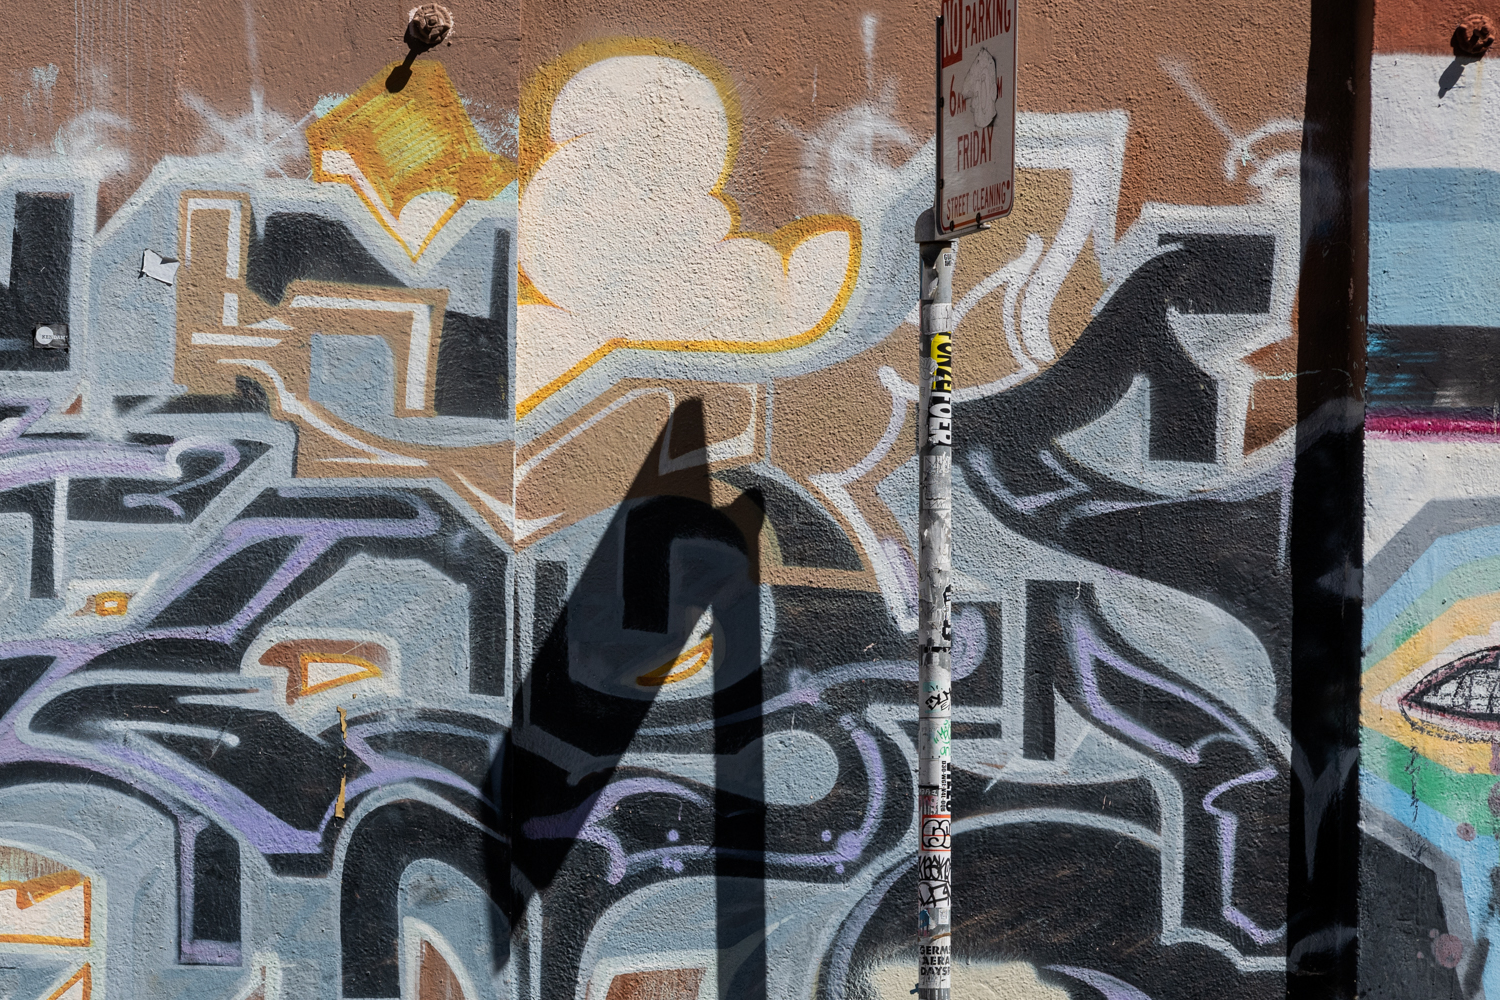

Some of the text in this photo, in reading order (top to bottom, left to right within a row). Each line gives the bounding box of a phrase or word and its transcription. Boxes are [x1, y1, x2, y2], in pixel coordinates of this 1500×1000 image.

[943, 0, 1011, 58] NO PARKING
[957, 126, 994, 172] FRIDAY
[946, 181, 1006, 220] STREET CLEANING
